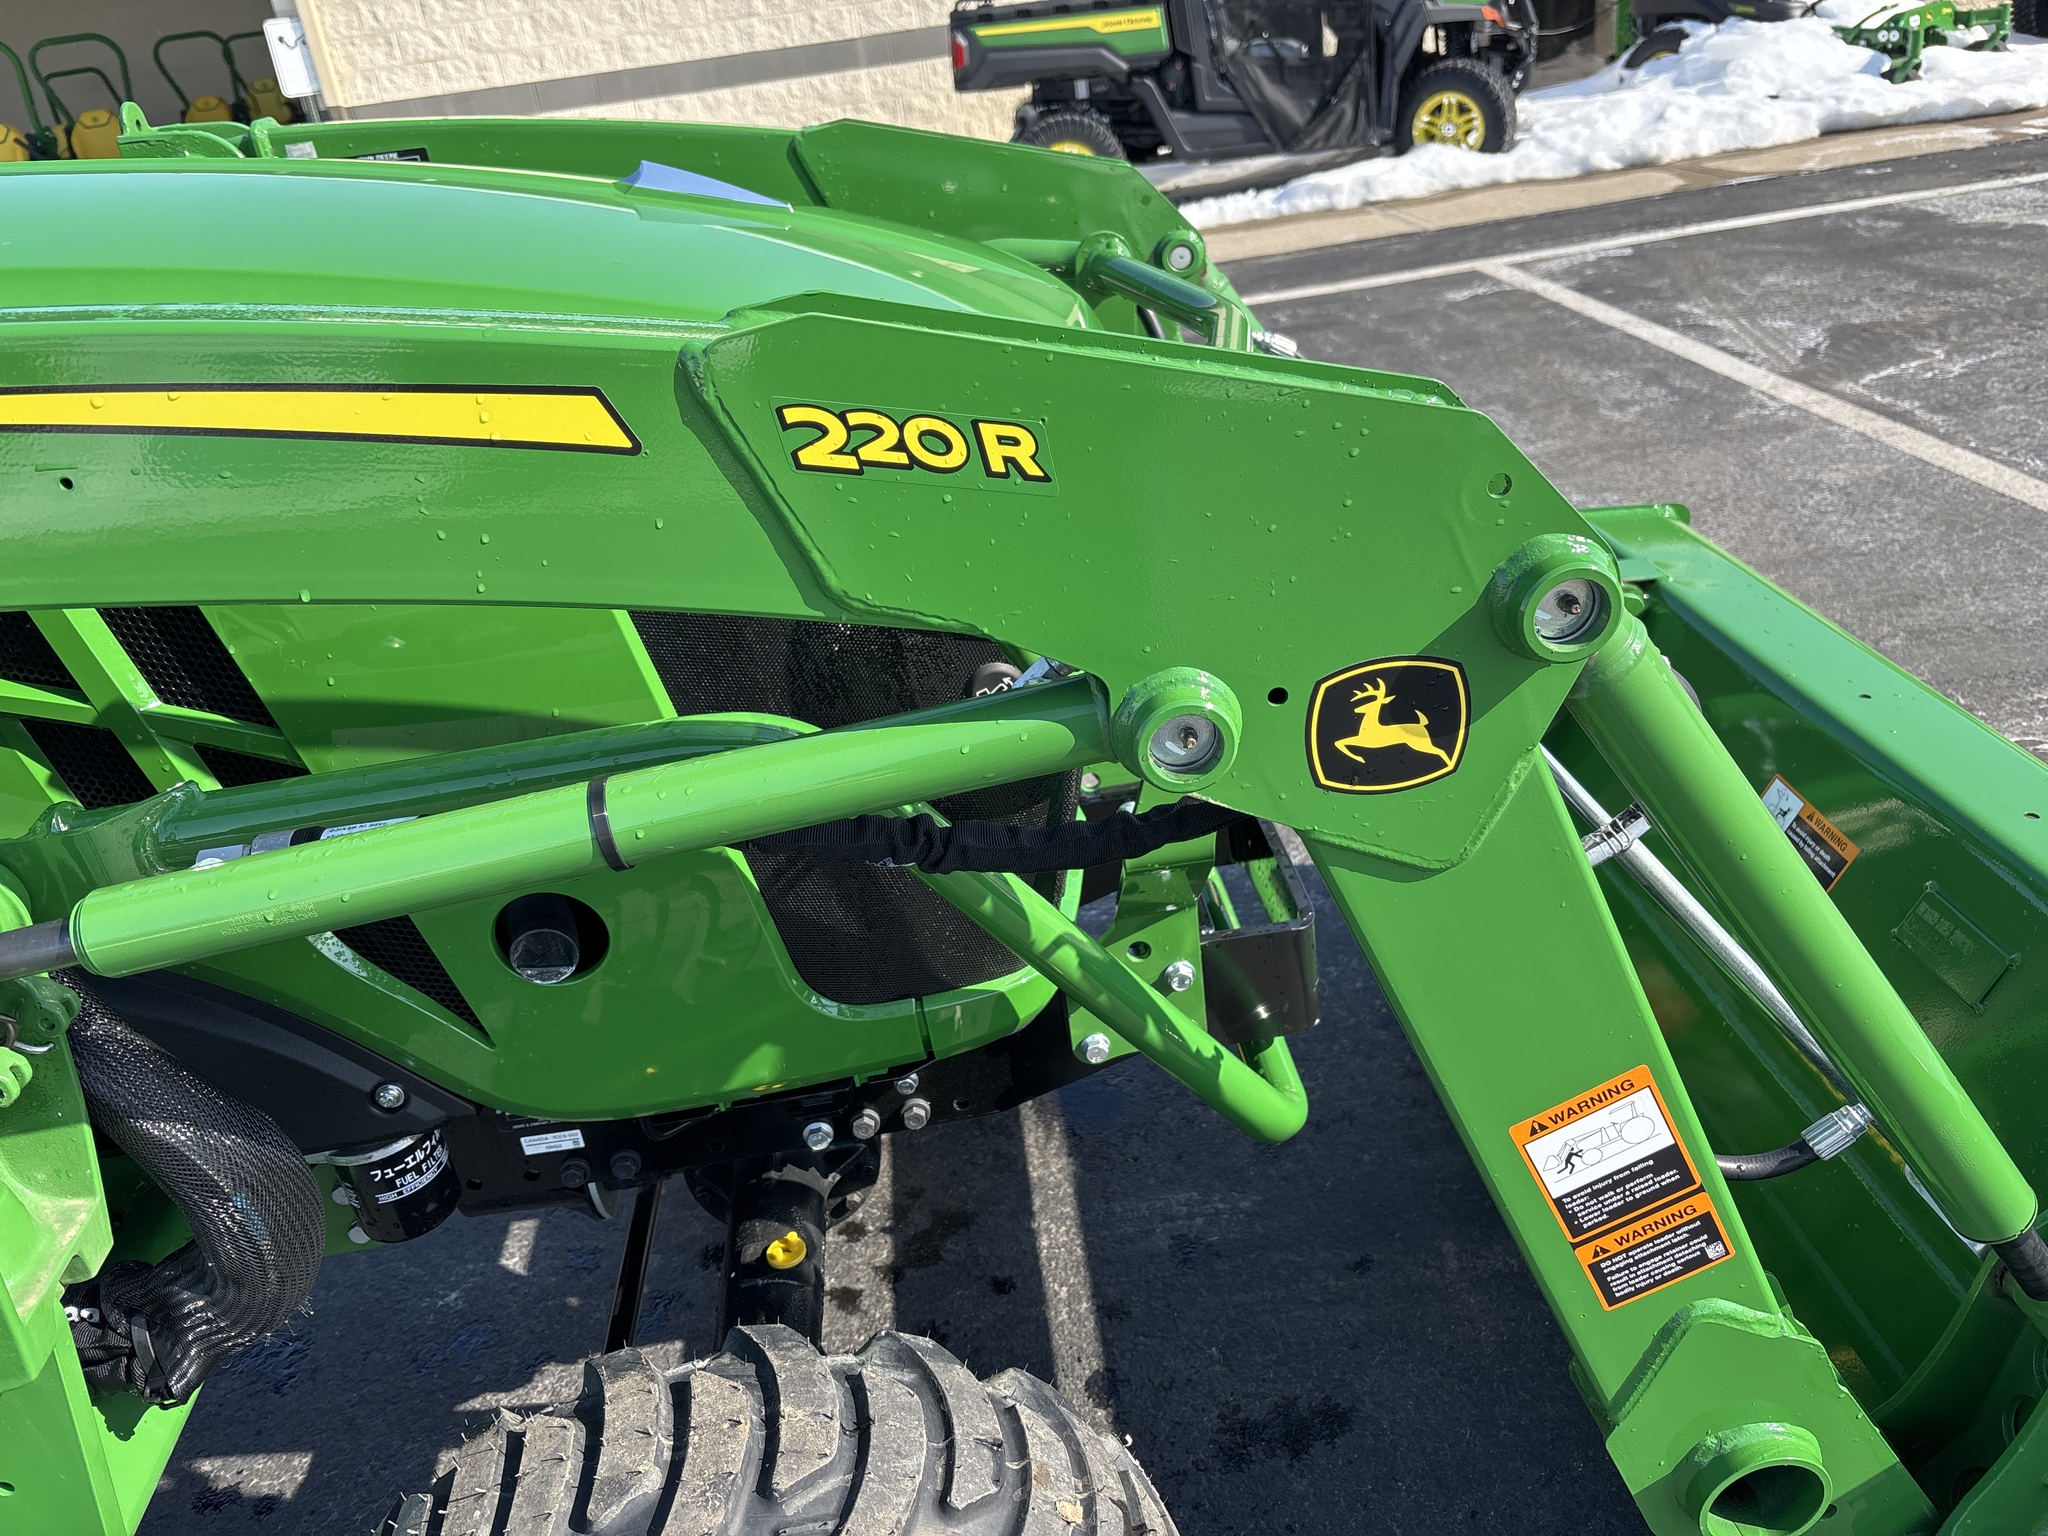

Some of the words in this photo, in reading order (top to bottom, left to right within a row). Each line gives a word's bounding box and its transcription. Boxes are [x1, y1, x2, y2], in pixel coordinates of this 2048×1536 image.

[1814, 817, 1848, 853] WARNING
[1548, 1079, 1635, 1125] WARNING
[523, 1135, 549, 1144] CANADA
[378, 1192, 398, 1202] HIGH
[402, 1166, 439, 1195] EFFICIENCY
[395, 1171, 420, 1188] FUEL
[421, 1144, 444, 1173] FILTER
[1572, 1187, 1592, 1199] avoid
[1592, 1178, 1612, 1190] injury
[1613, 1170, 1631, 1180] from
[1631, 1159, 1654, 1172] falling
[1565, 1195, 1590, 1210] loader:
[1577, 1203, 1602, 1217] service
[1603, 1193, 1624, 1206] under
[1631, 1179, 1653, 1193] raised
[1579, 1210, 1601, 1223] Lower
[1601, 1200, 1624, 1213] loader
[1634, 1183, 1660, 1199] ground
[1660, 1174, 1681, 1186] when
[1585, 1198, 1598, 1207] not
[1598, 1191, 1615, 1201] walk
[1625, 1173, 1654, 1189] perform
[1600, 1260, 1611, 1268] DO
[1611, 1252, 1627, 1264] NOT
[1628, 1242, 1653, 1256] operate
[1653, 1232, 1675, 1244] loader
[1675, 1220, 1701, 1235] without
[1613, 1204, 1697, 1246] WARNING
[1603, 1257, 1634, 1274] engaging
[1634, 1240, 1671, 1260] attachment
[1606, 1269, 1629, 1282] Failure
[1638, 1255, 1662, 1268] engage
[1662, 1243, 1688, 1257] retainer
[1689, 1233, 1708, 1246] could
[1610, 1275, 1629, 1287] result
[1636, 1256, 1674, 1276] attachment
[1674, 1241, 1707, 1259] detaching
[1612, 1282, 1628, 1292] from
[1628, 1273, 1649, 1285] loader
[1650, 1262, 1676, 1276] causing
[1676, 1250, 1701, 1264] serious
[1614, 1286, 1635, 1297] bodily
[1635, 1277, 1654, 1288] injury
